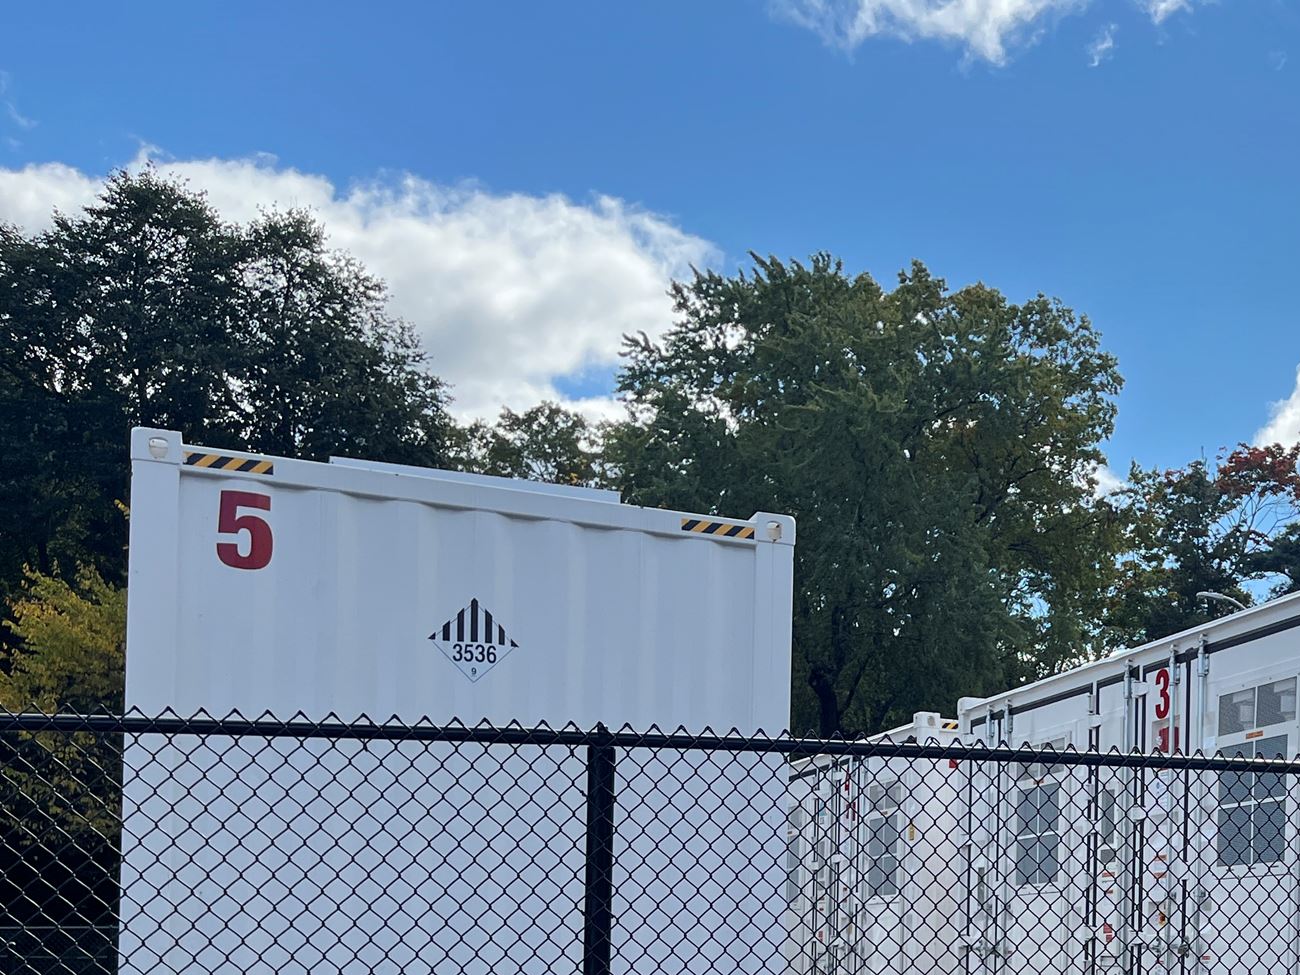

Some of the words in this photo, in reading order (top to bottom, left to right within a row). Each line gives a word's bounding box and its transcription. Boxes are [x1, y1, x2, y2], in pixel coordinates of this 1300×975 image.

[216, 490, 273, 570] 5
[452, 643, 497, 664] 3536
[471, 667, 477, 675] 9
[1155, 667, 1170, 720] 3
